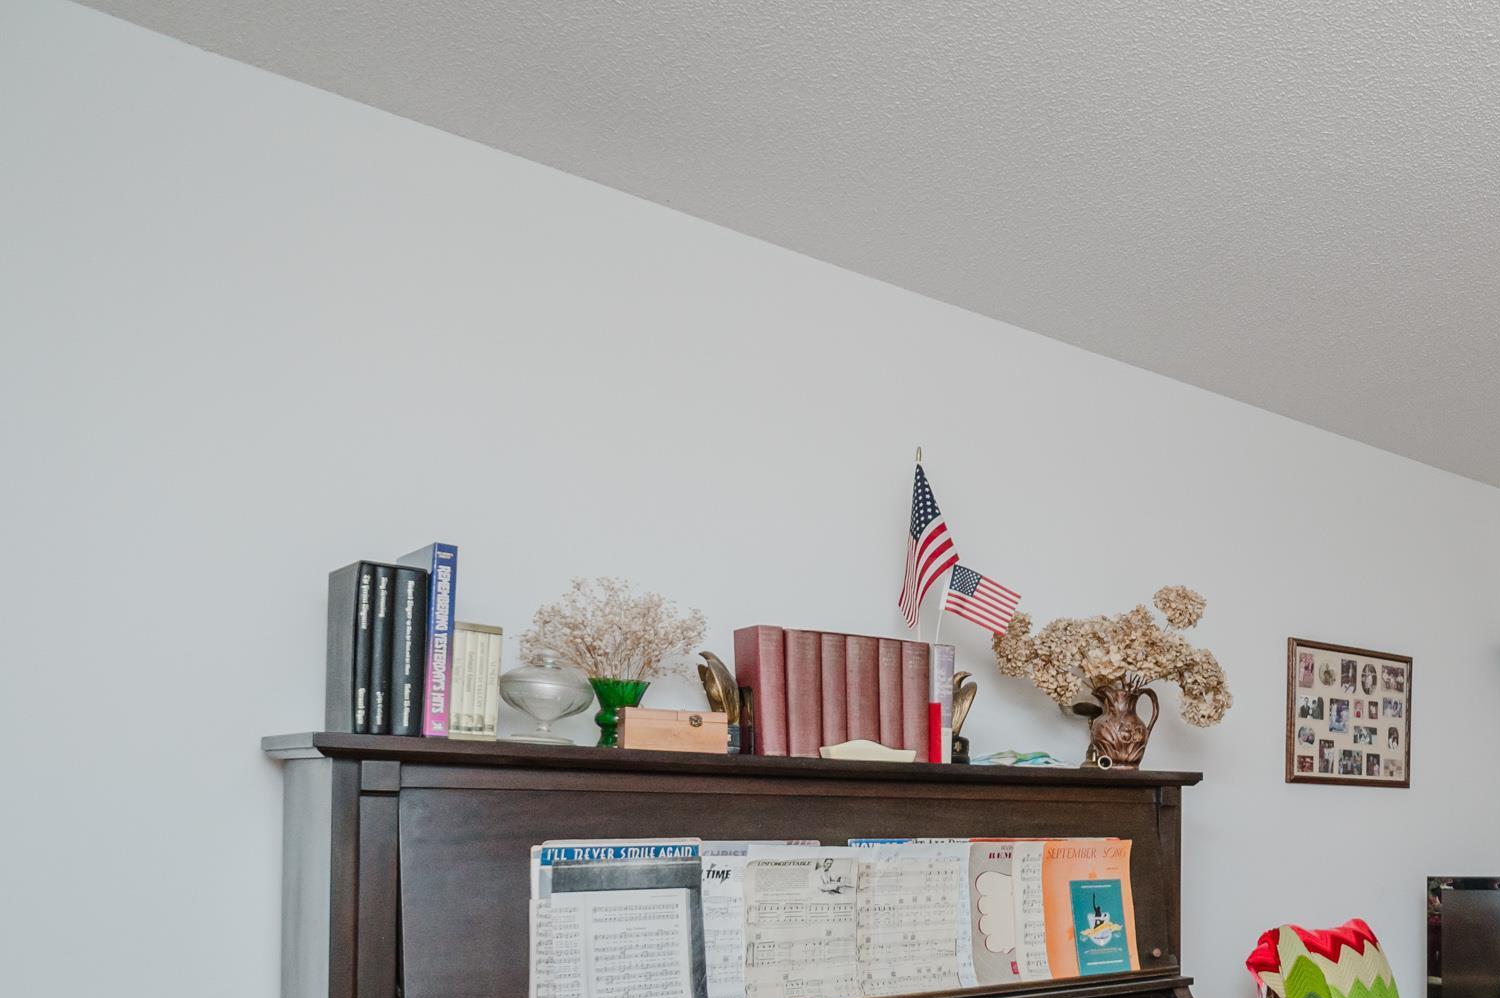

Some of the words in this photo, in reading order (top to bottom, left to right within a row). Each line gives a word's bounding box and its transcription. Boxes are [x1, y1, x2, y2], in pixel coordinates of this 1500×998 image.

[434, 565, 451, 631] REMEMBERING
[431, 691, 445, 714] HITS
[546, 848, 567, 861] I'LL
[574, 847, 614, 860] NEVER
[620, 847, 655, 859] SMILE
[657, 846, 692, 858] AGAIN
[1047, 847, 1097, 860] SEPTEMBER
[705, 869, 732, 881] TIME
